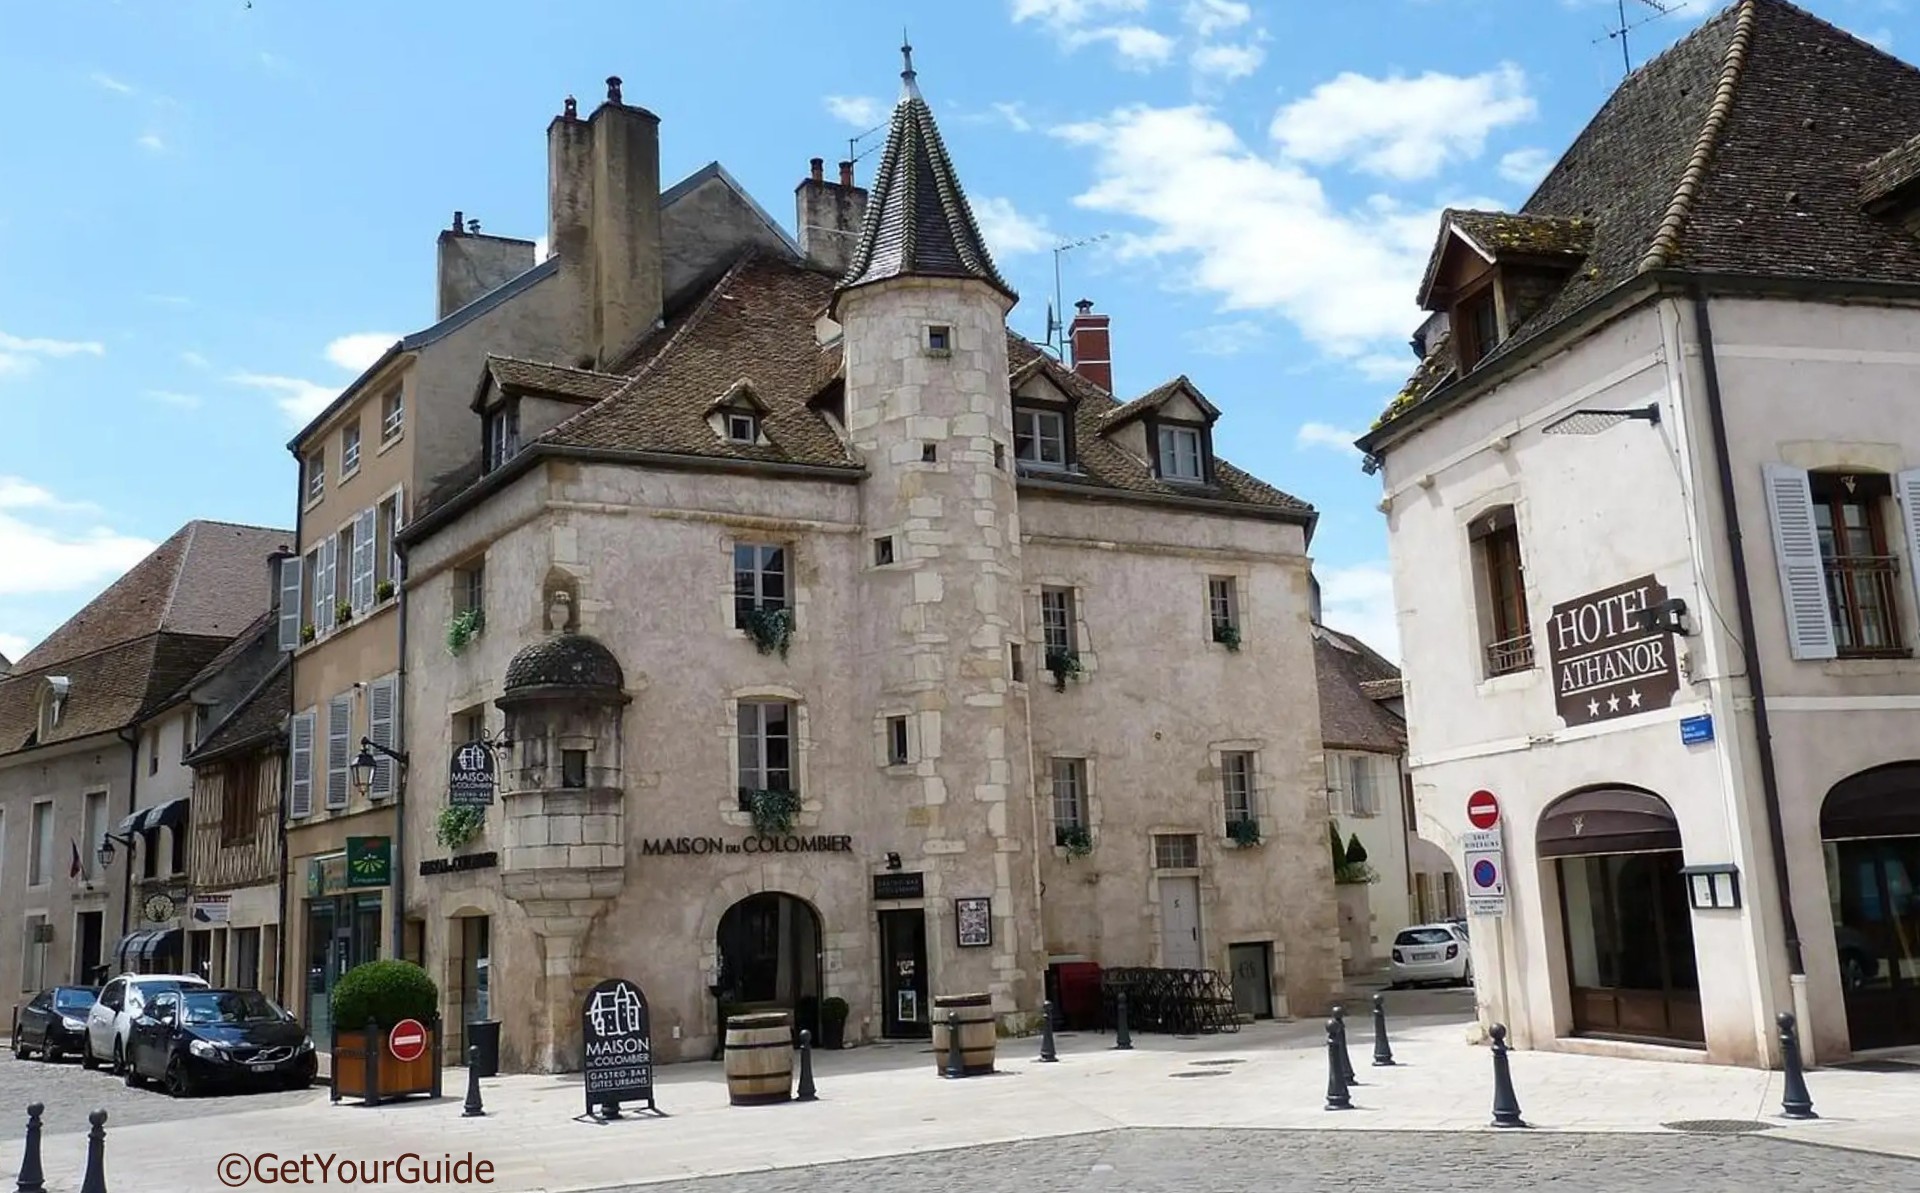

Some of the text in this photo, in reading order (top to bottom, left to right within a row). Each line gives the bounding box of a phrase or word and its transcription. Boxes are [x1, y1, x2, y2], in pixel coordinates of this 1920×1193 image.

[1560, 640, 1668, 691] ATHANOR
[642, 835, 853, 856] MAISON DU COLOMBIER
[586, 1037, 650, 1056] MAISON
[595, 1053, 649, 1066] COLOMBIER
